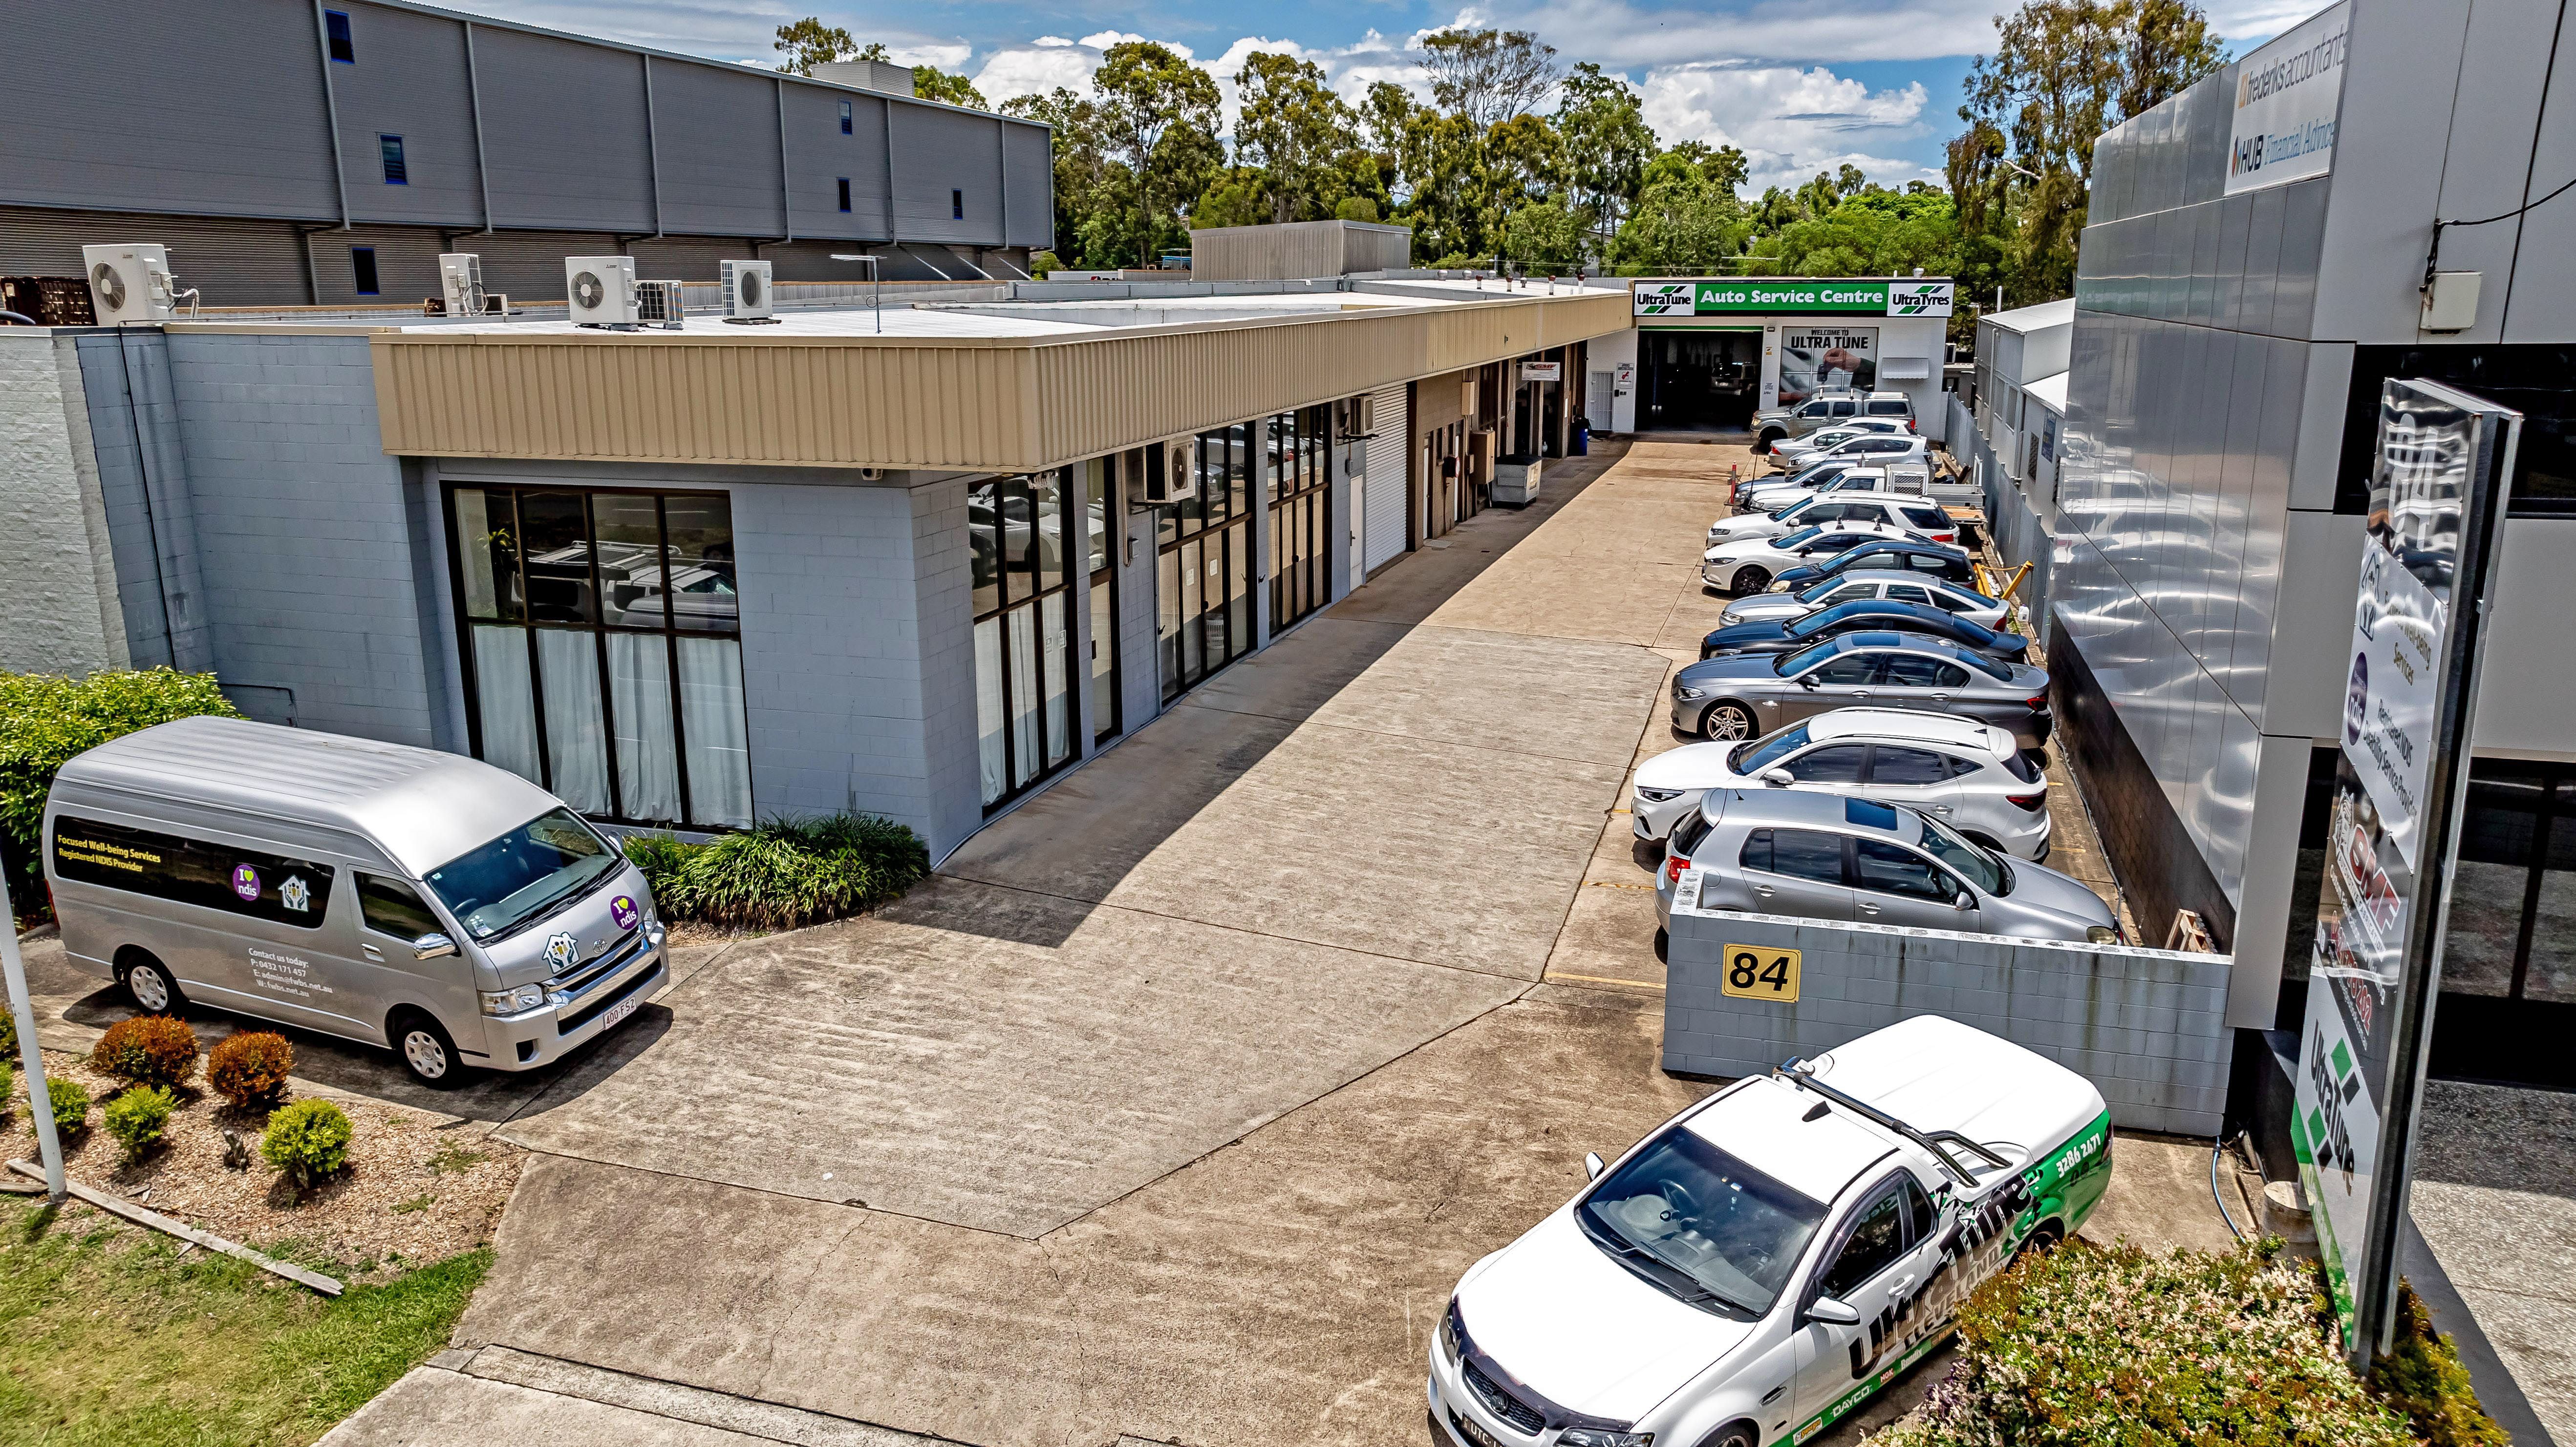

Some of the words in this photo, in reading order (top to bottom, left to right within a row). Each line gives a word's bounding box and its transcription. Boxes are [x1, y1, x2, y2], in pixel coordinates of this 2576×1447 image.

[2247, 57, 2285, 106] frederiks
[2240, 134, 2264, 174] HUB
[2264, 124, 2303, 165] Financial
[1637, 294, 1691, 306] UltraTune
[1700, 290, 1747, 303] Auto
[1751, 289, 1815, 303] Service
[1820, 289, 1884, 303] Centre
[1892, 293, 1950, 306] UltraTyres
[1791, 336, 1832, 349] ULTRA
[1834, 336, 1868, 349] TUNE
[2388, 413, 2438, 552] 84
[2394, 641, 2414, 686] Services
[2348, 694, 2363, 730] ndis
[2362, 718, 2383, 769] Disability
[2382, 748, 2398, 793] Service
[2399, 729, 2413, 770] NDIS
[58, 834, 87, 848] Focused
[88, 840, 129, 858] Well-being
[130, 849, 161, 863] Services
[59, 848, 95, 862] Registered
[96, 855, 113, 866] NDIS
[113, 858, 143, 872] Provider
[239, 869, 245, 881] I
[238, 884, 257, 897] ndis
[613, 902, 623, 914] I
[620, 910, 637, 928] ndis
[249, 948, 276, 960] Contact
[286, 956, 309, 968] today:
[251, 958, 258, 967] P:
[258, 960, 277, 971] 0432
[279, 964, 291, 974] 171
[293, 968, 306, 977] 457
[257, 979, 266, 987] W:
[1729, 952, 1790, 992] 84
[2311, 1018, 2355, 1197] UltraTune
[2056, 1146, 2081, 1178] 3286
[2080, 1132, 2101, 1158] 2471
[1901, 1348, 1922, 1370] Bendix
[1880, 1369, 1894, 1383] NGK
[1832, 1385, 1871, 1418] DAYCO
